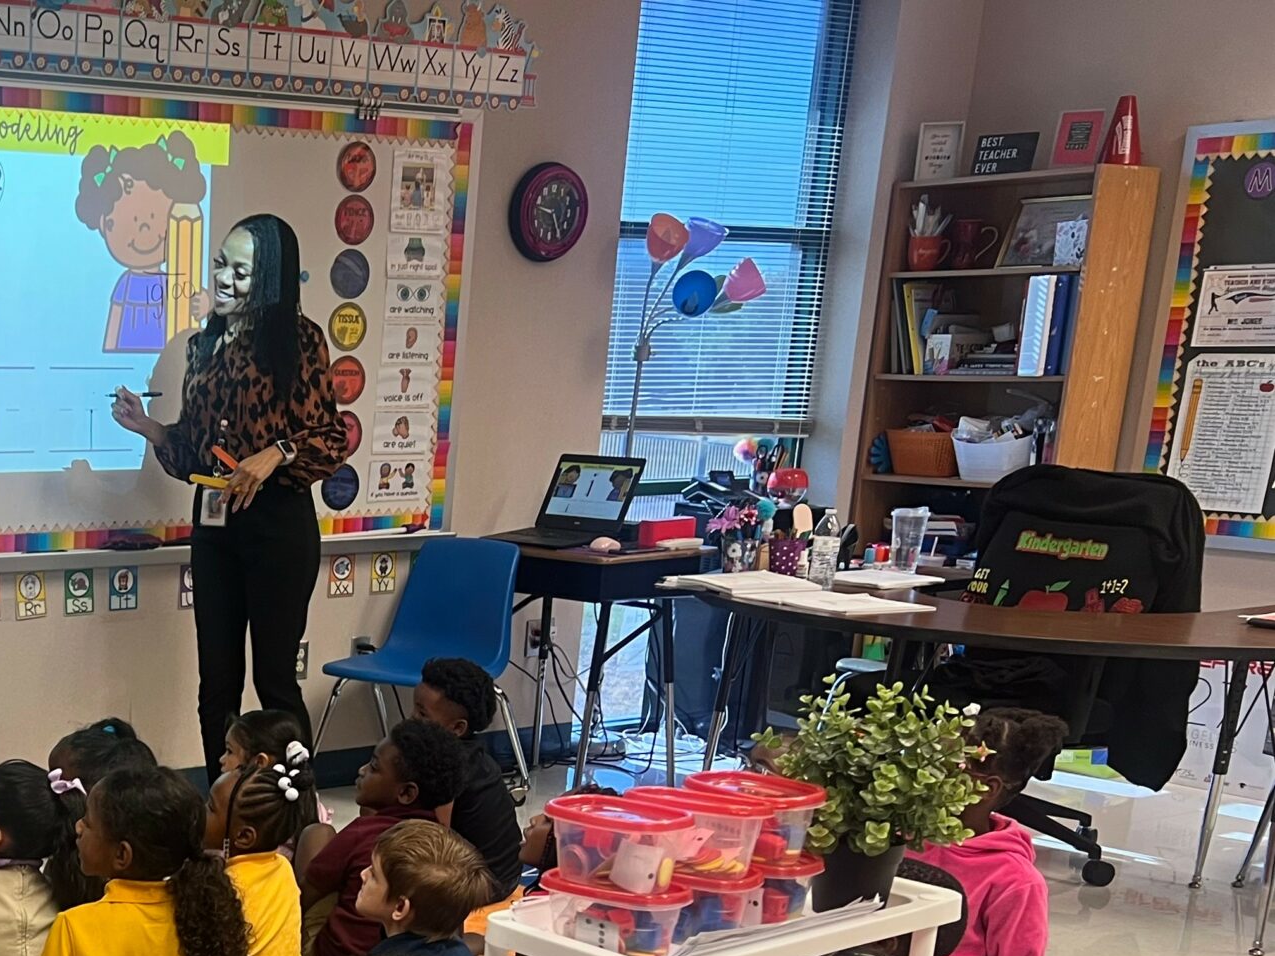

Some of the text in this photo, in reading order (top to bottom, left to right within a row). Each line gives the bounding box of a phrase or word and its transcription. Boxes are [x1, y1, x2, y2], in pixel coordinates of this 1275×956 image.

[37, 10, 74, 41] Oo
[84, 14, 114, 59] Pp
[125, 19, 165, 63] Qq
[176, 24, 204, 53] Rr
[215, 28, 241, 58] Ss
[258, 32, 283, 60] Tt
[298, 35, 326, 65] Uu
[340, 39, 363, 68] Vv
[373, 43, 416, 73] Ww
[422, 48, 447, 78] Xx
[461, 51, 482, 90] Yy
[496, 55, 520, 84] Zz
[981, 136, 1005, 147] BEST
[978, 148, 1018, 160] TEACHER
[974, 162, 998, 174] EVER
[1248, 167, 1273, 192] M
[409, 263, 424, 273] right
[404, 305, 435, 316] watching
[337, 313, 360, 324] TISSUE
[387, 352, 429, 361] are listening
[1196, 359, 1266, 368] the ABC's
[383, 394, 403, 402] voice
[412, 393, 424, 401] off
[383, 440, 417, 450] are quiet
[1016, 530, 1109, 560] Kindergarten
[974, 568, 991, 580] GET
[25, 600, 41, 616] Rr
[71, 598, 89, 614] Ss
[333, 581, 350, 595] Xx
[376, 577, 390, 591] Yy
